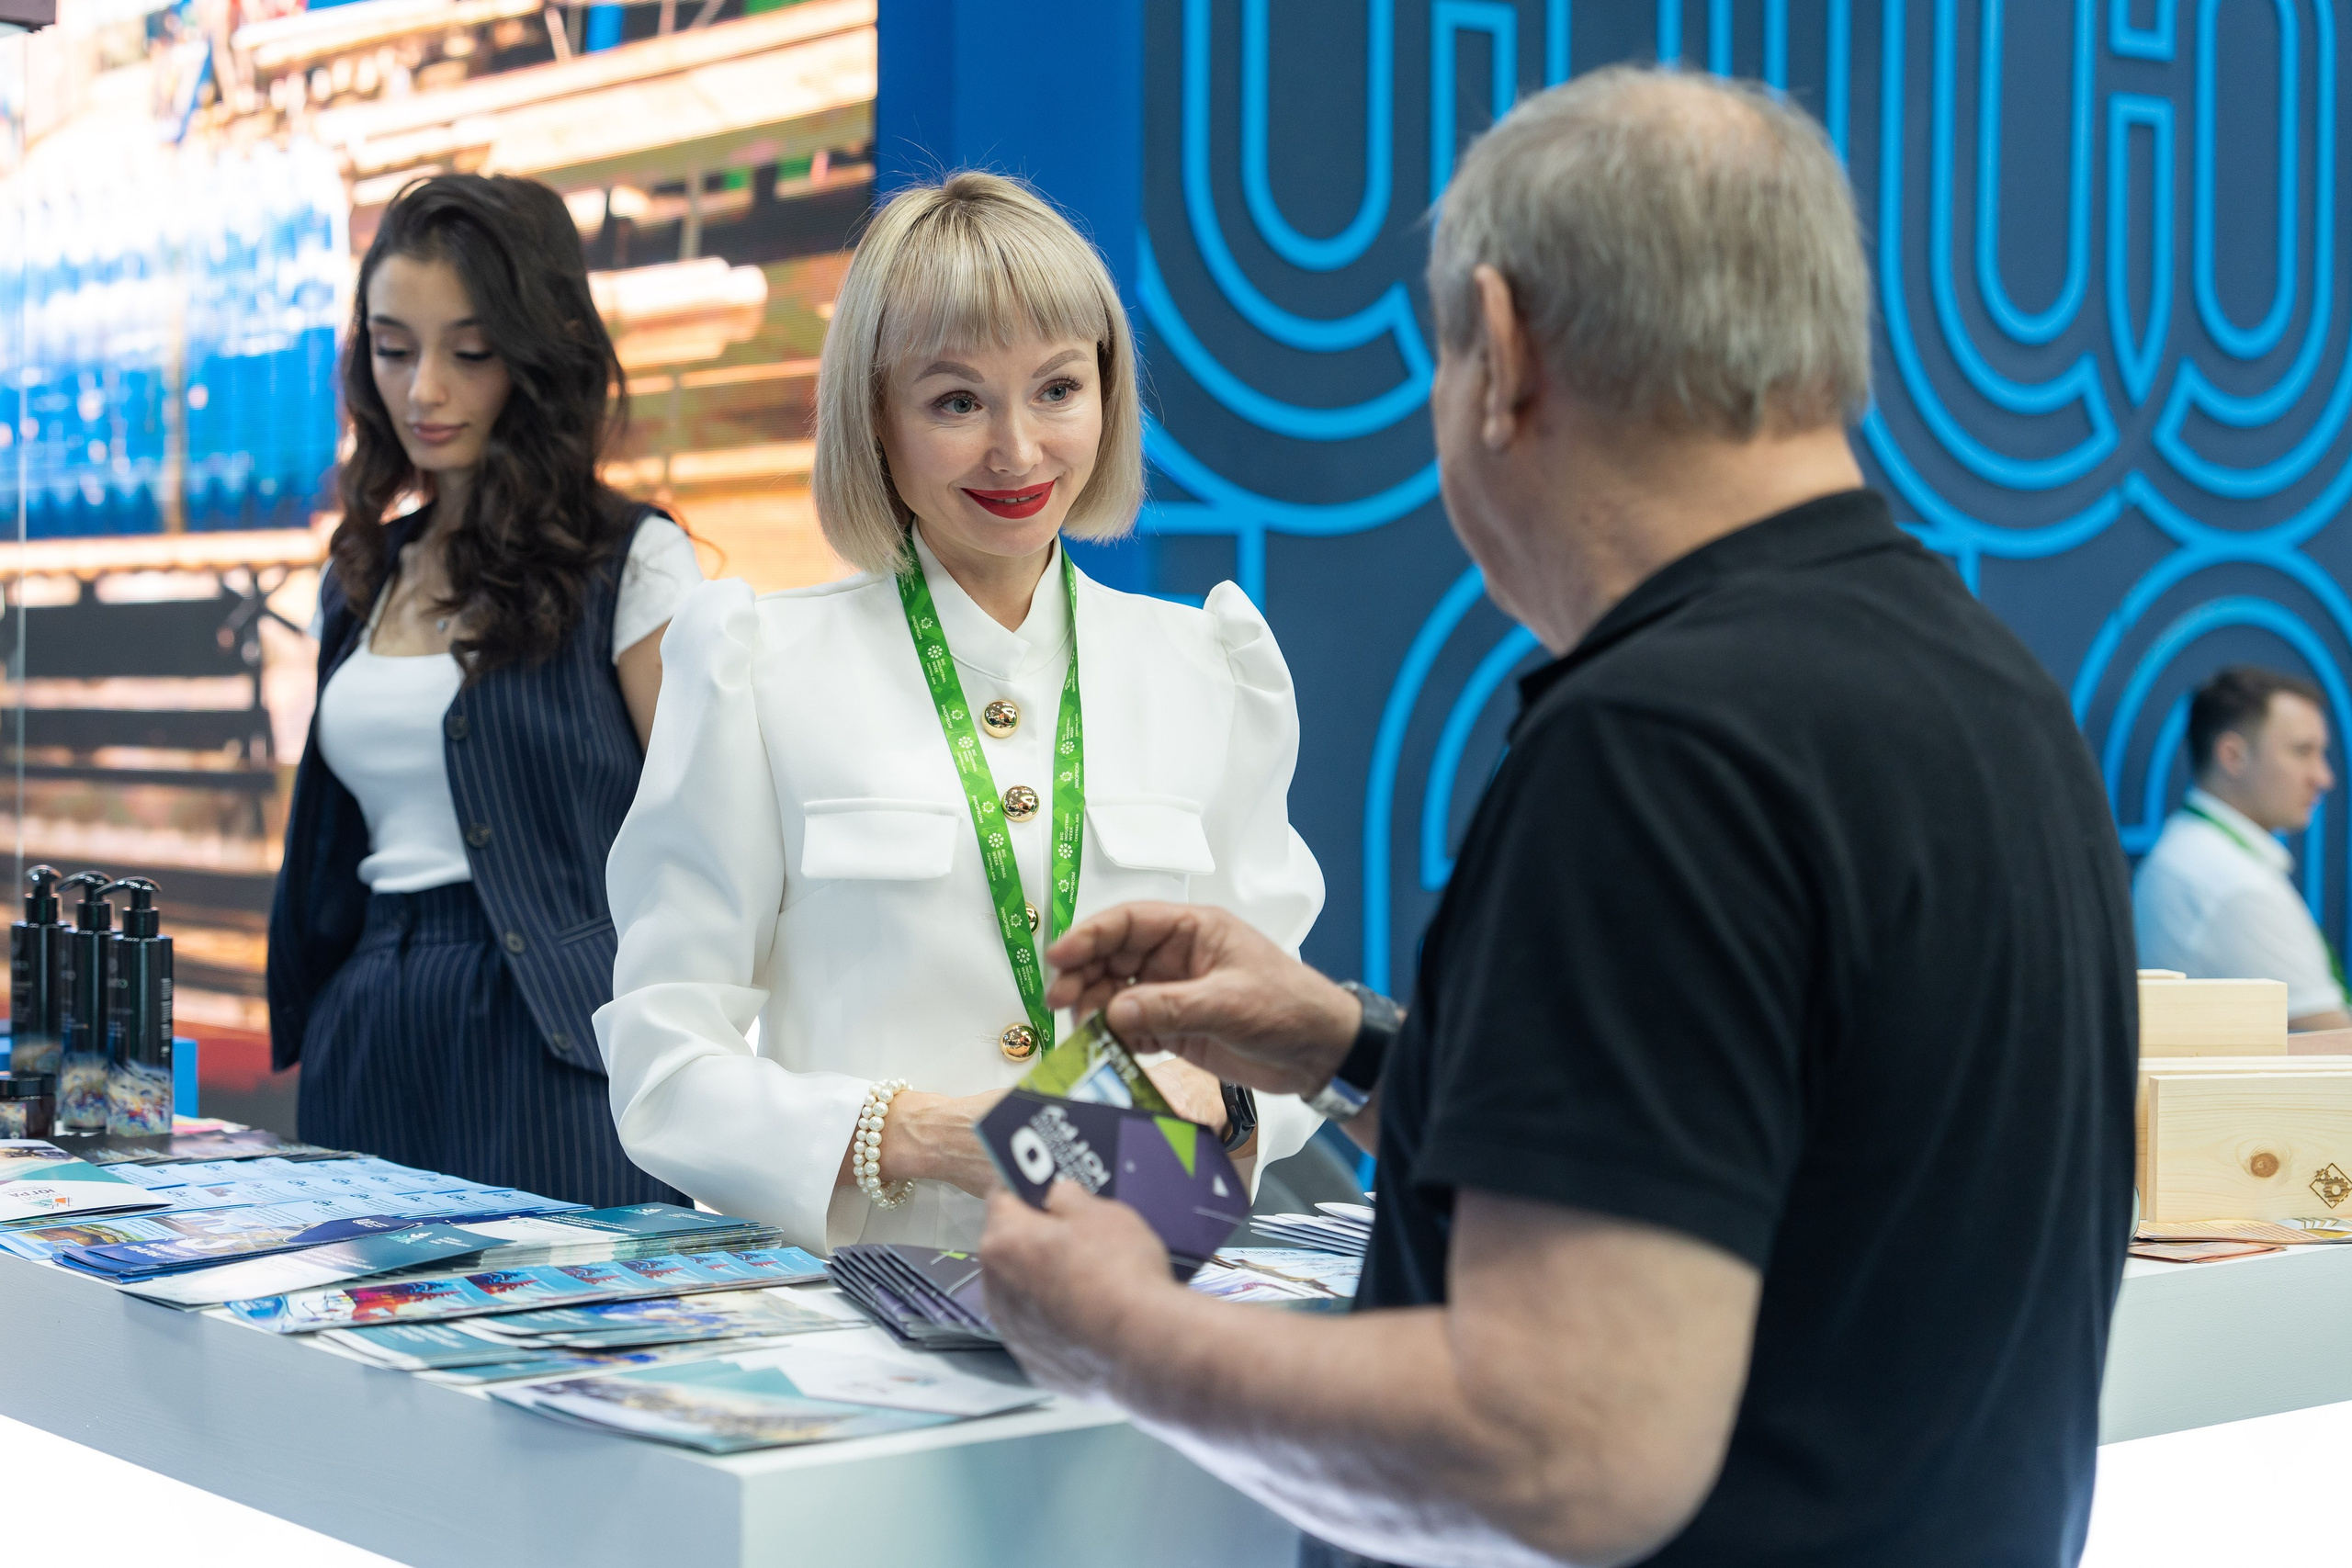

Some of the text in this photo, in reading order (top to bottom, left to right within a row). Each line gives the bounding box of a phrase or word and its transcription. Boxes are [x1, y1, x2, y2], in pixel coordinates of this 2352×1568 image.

[911, 615, 922, 640] INNOPROM
[941, 704, 953, 729] INNOPROM
[972, 795, 984, 824] INNOPROM
[997, 850, 1007, 879] INDUSTRIAL
[1000, 907, 1012, 939] INNOPROM
[1024, 965, 1035, 995] INDUSTRIAL
[8, 1189, 56, 1198] ЮГРА
